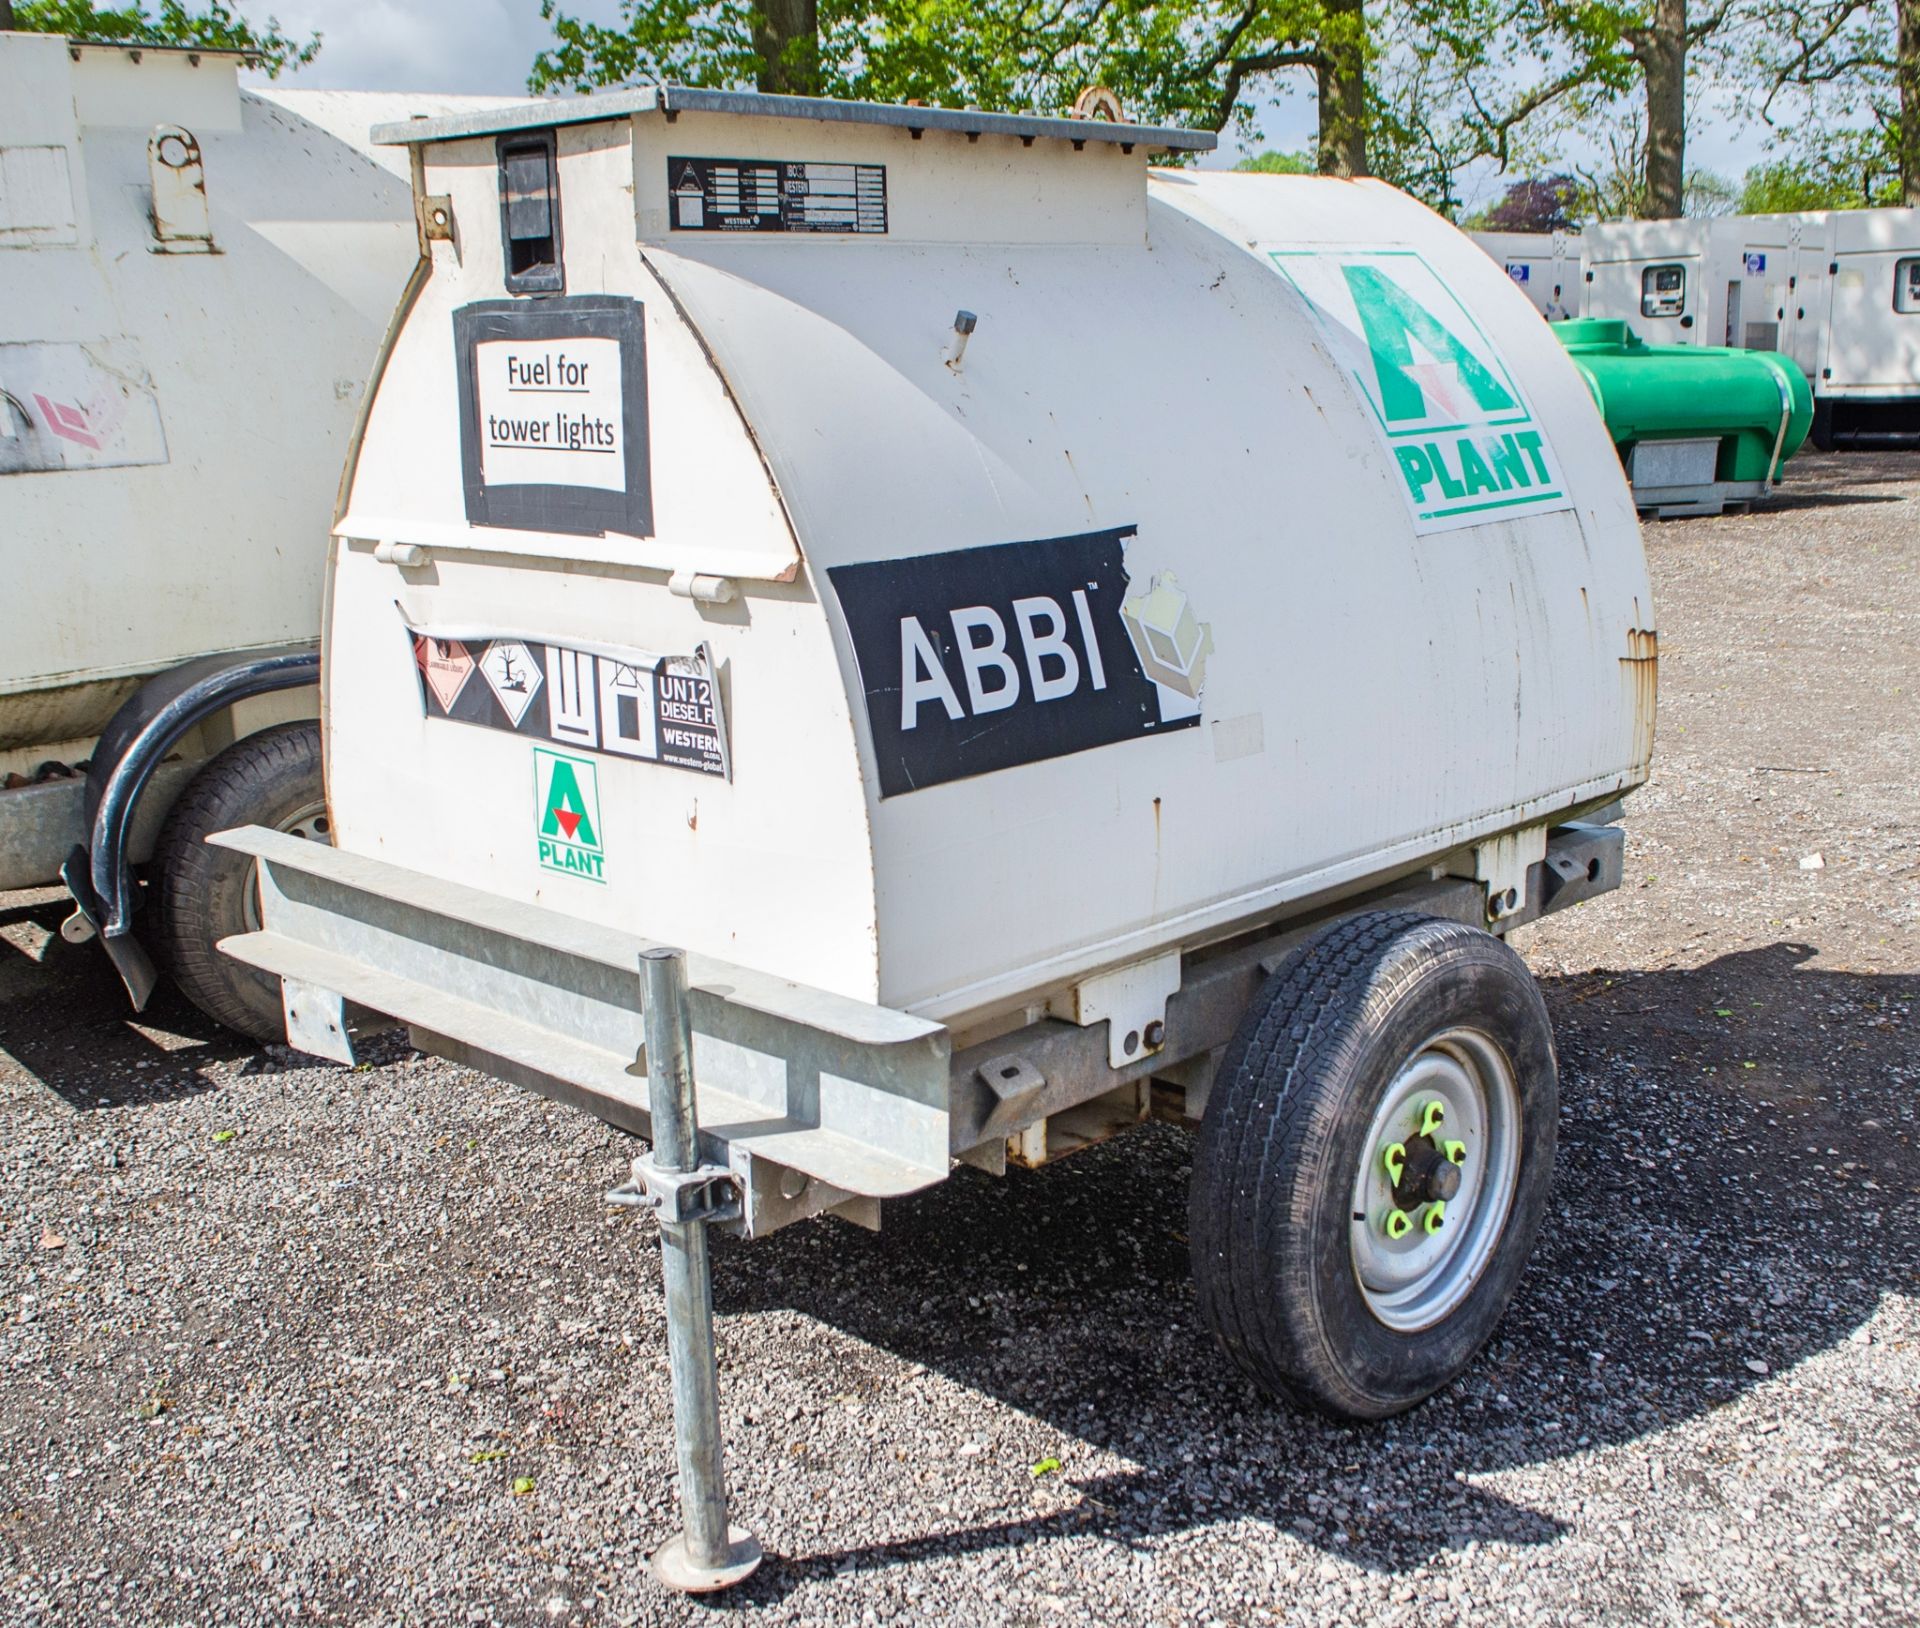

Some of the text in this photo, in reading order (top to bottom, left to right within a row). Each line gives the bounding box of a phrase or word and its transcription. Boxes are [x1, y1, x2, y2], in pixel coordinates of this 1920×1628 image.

[508, 354, 588, 385] Fuel for
[489, 413, 614, 450] tower lights
[1393, 430, 1551, 504] PLANT
[900, 589, 1106, 730] ABBI
[661, 701, 703, 723] DIESEL
[663, 728, 720, 752] WESTERN
[538, 839, 604, 877] PLANT
